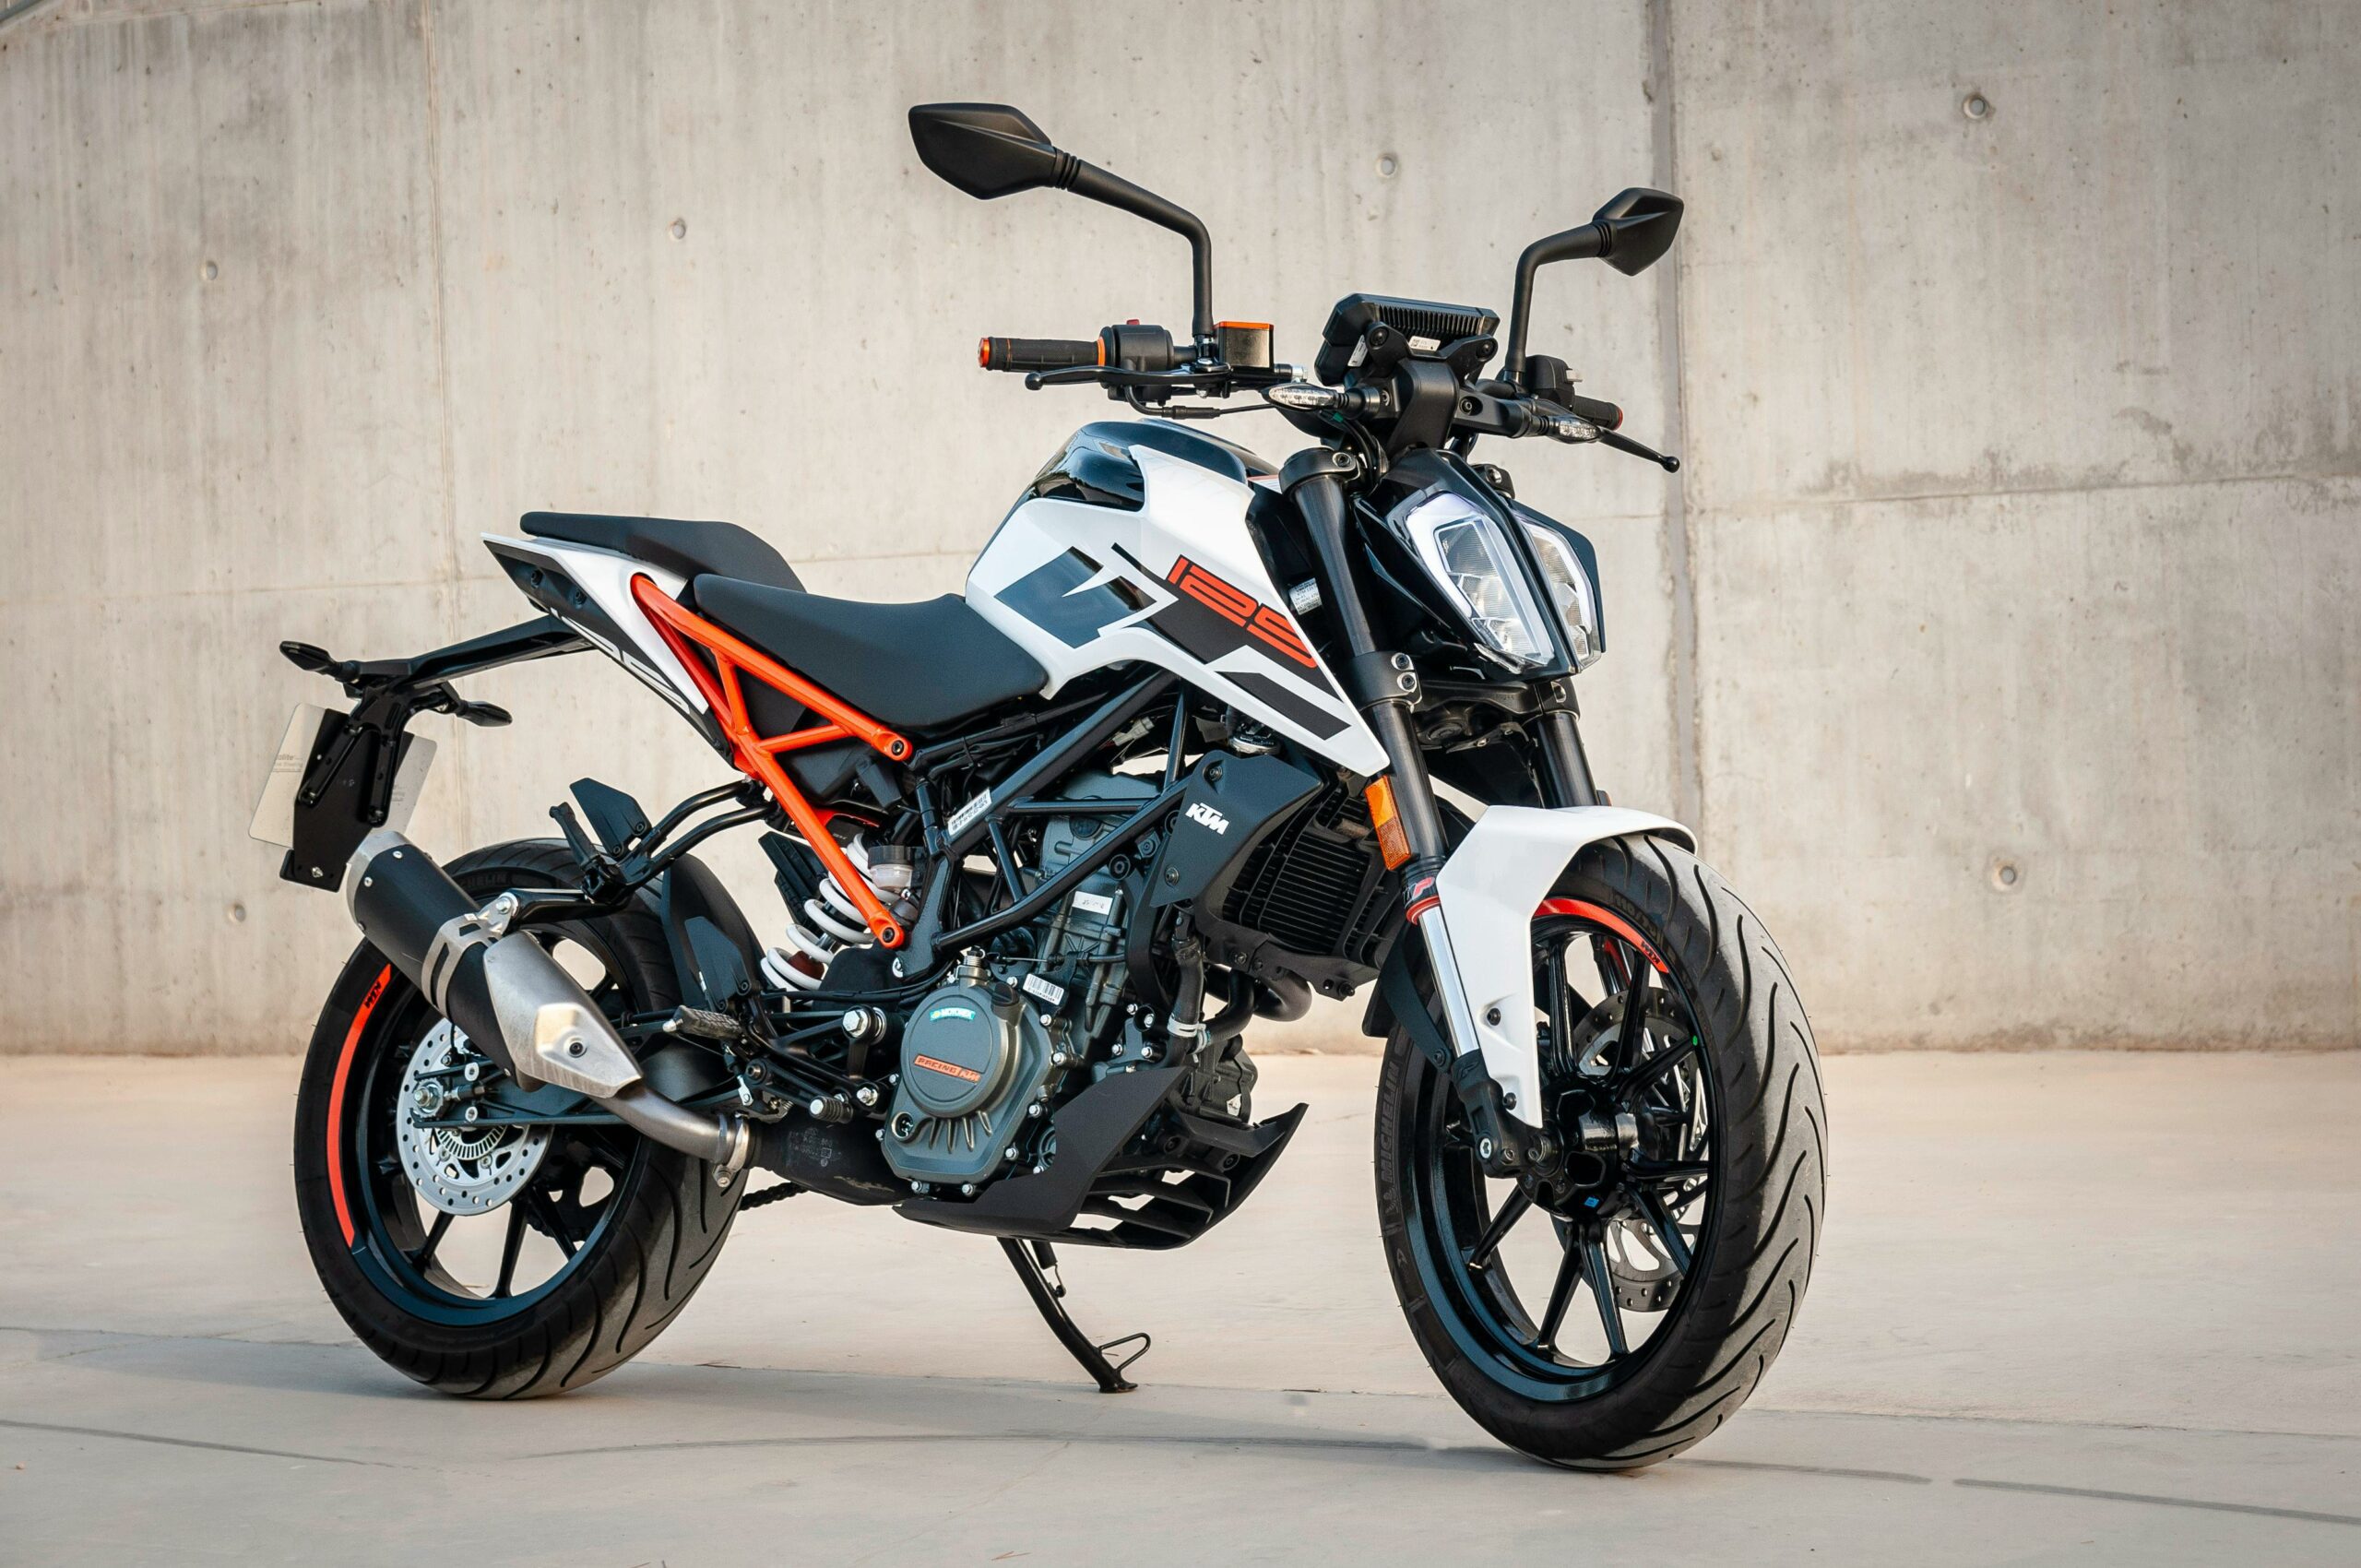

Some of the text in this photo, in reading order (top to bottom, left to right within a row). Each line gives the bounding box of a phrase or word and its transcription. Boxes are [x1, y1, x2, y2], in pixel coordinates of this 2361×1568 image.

[1184, 802, 1229, 835] KTM
[363, 981, 381, 1009] KTM
[917, 1057, 957, 1074] RACING
[1381, 1061, 1401, 1184] MICHELIN
